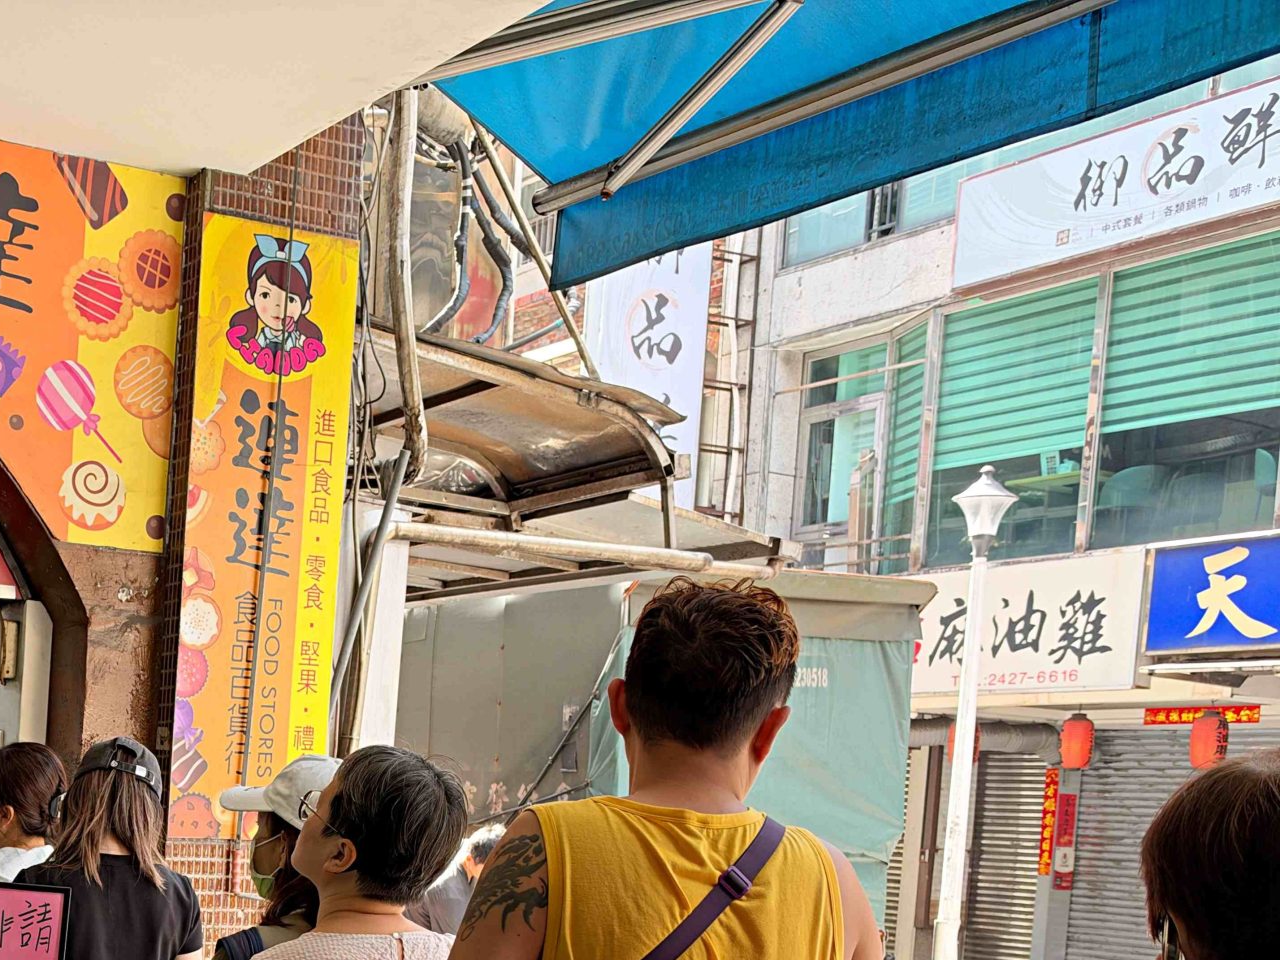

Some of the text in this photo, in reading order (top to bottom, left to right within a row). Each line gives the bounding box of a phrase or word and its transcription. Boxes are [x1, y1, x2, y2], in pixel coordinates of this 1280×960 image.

[255, 598, 283, 778] FOOD STORES
[292, 408, 337, 756] 進口食品·零食·堅果·禮
